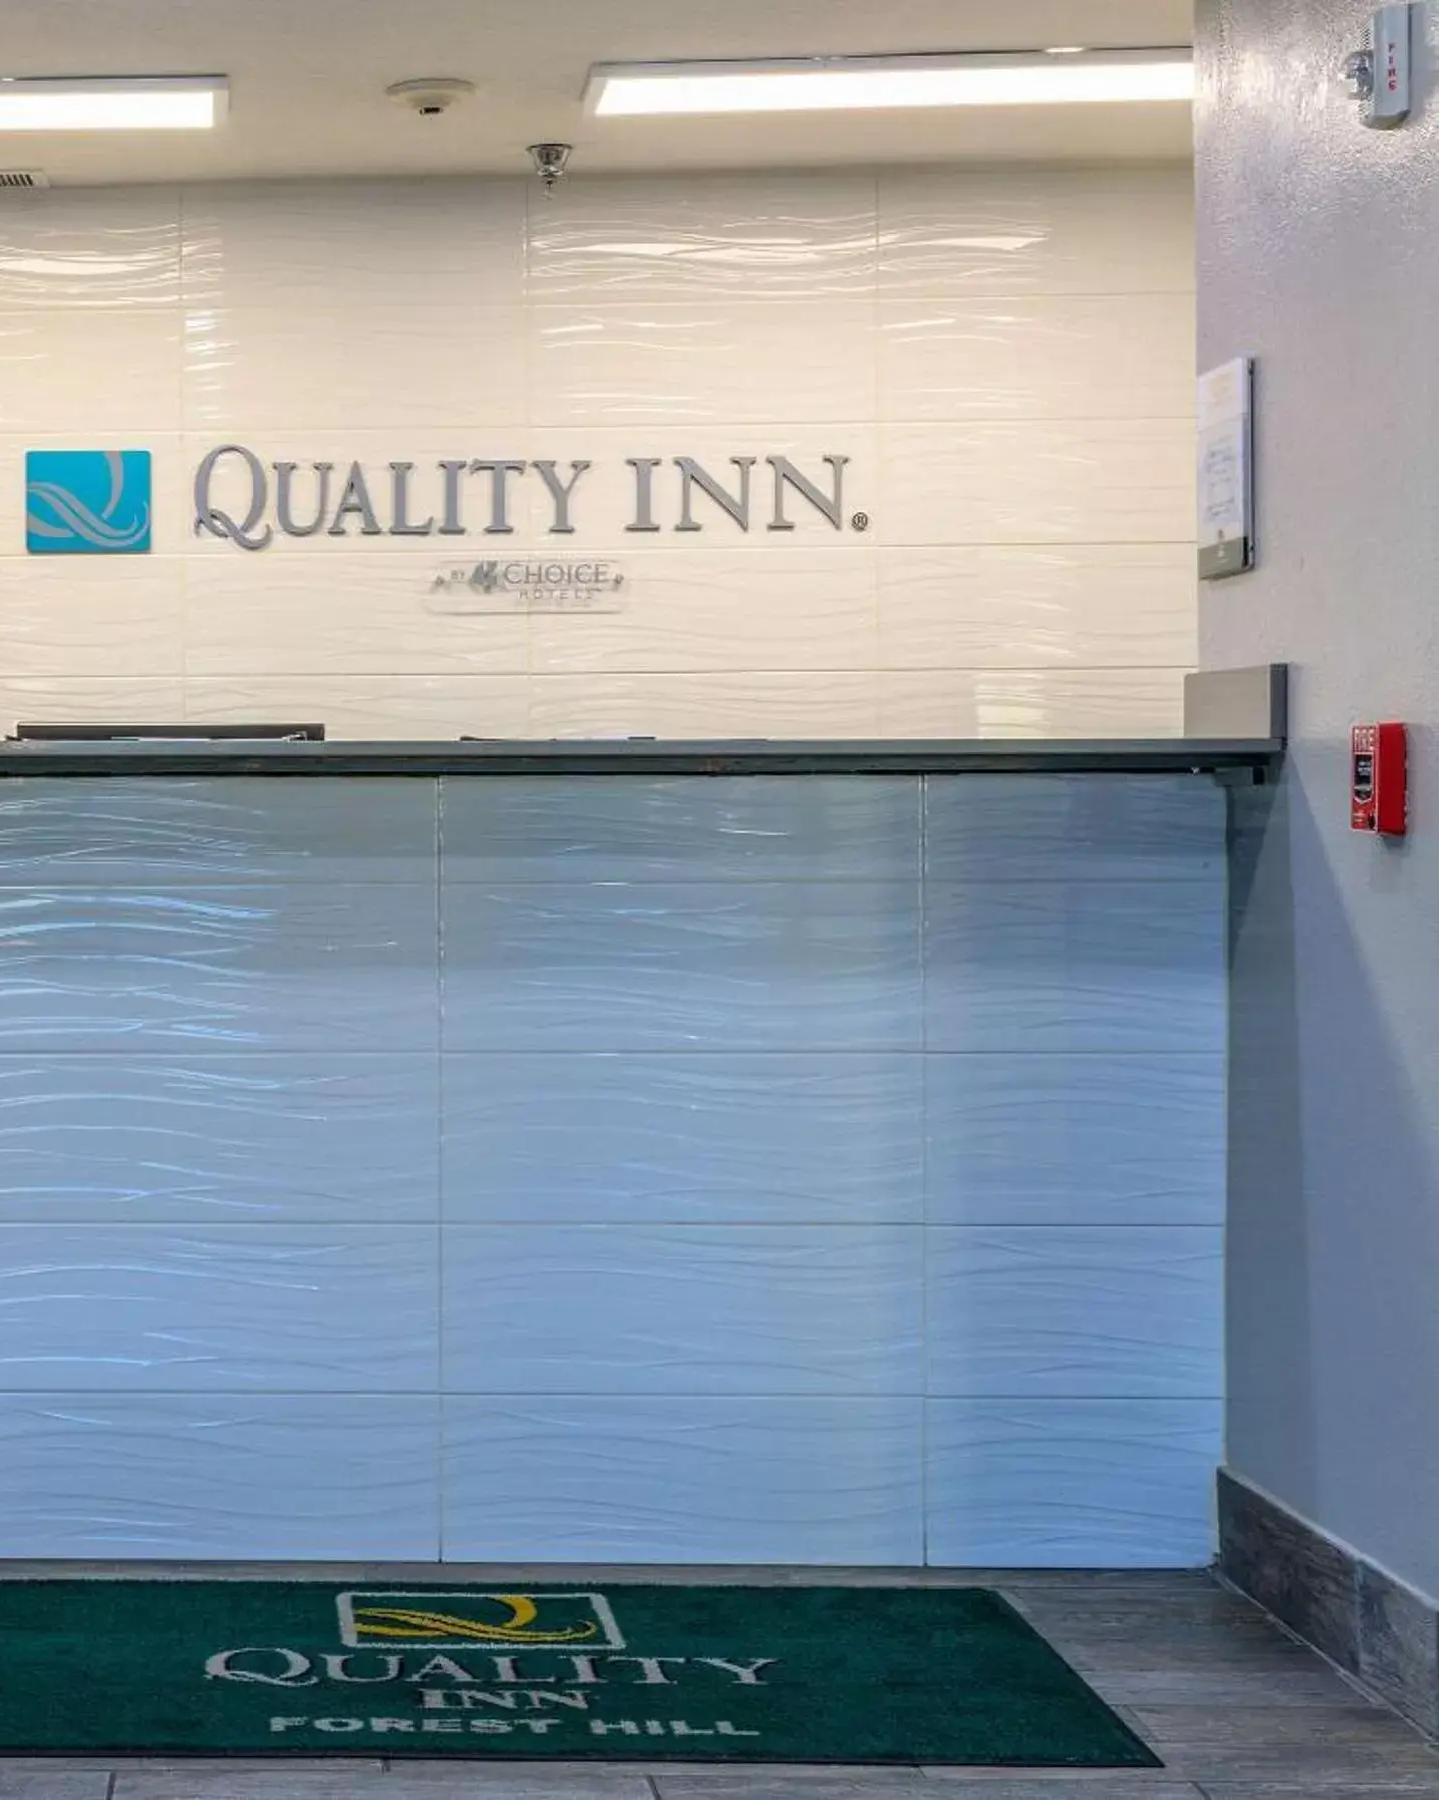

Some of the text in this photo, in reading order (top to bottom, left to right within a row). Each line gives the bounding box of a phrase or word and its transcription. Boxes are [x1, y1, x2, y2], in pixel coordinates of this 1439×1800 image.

[193, 443, 591, 550] QUALITY
[503, 563, 610, 585] CHOICE
[204, 1647, 779, 1687] QUALITY
[416, 1687, 594, 1709] INN
[268, 1716, 761, 1736] FOREST HILL
